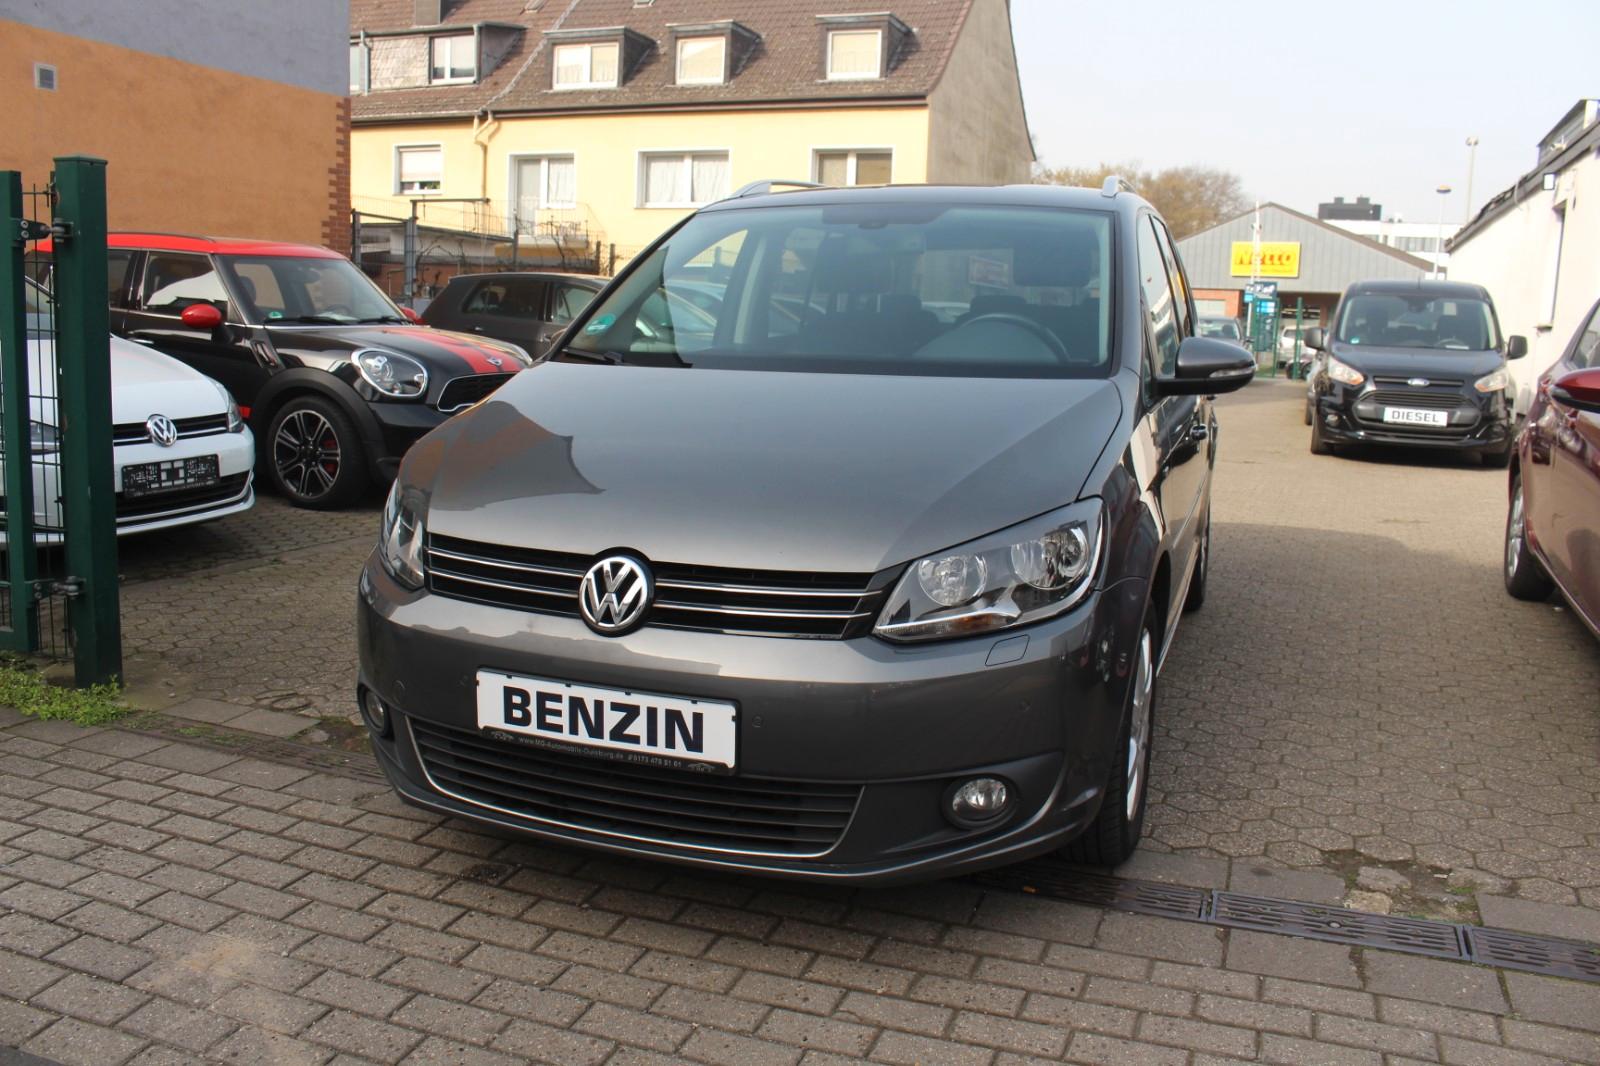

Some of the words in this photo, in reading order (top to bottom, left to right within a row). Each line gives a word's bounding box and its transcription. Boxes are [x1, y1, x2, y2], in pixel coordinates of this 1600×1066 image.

[150, 416, 177, 446] VW
[1392, 410, 1439, 423] DIESEL
[583, 559, 645, 627] VW
[503, 685, 704, 753] BENZIN
